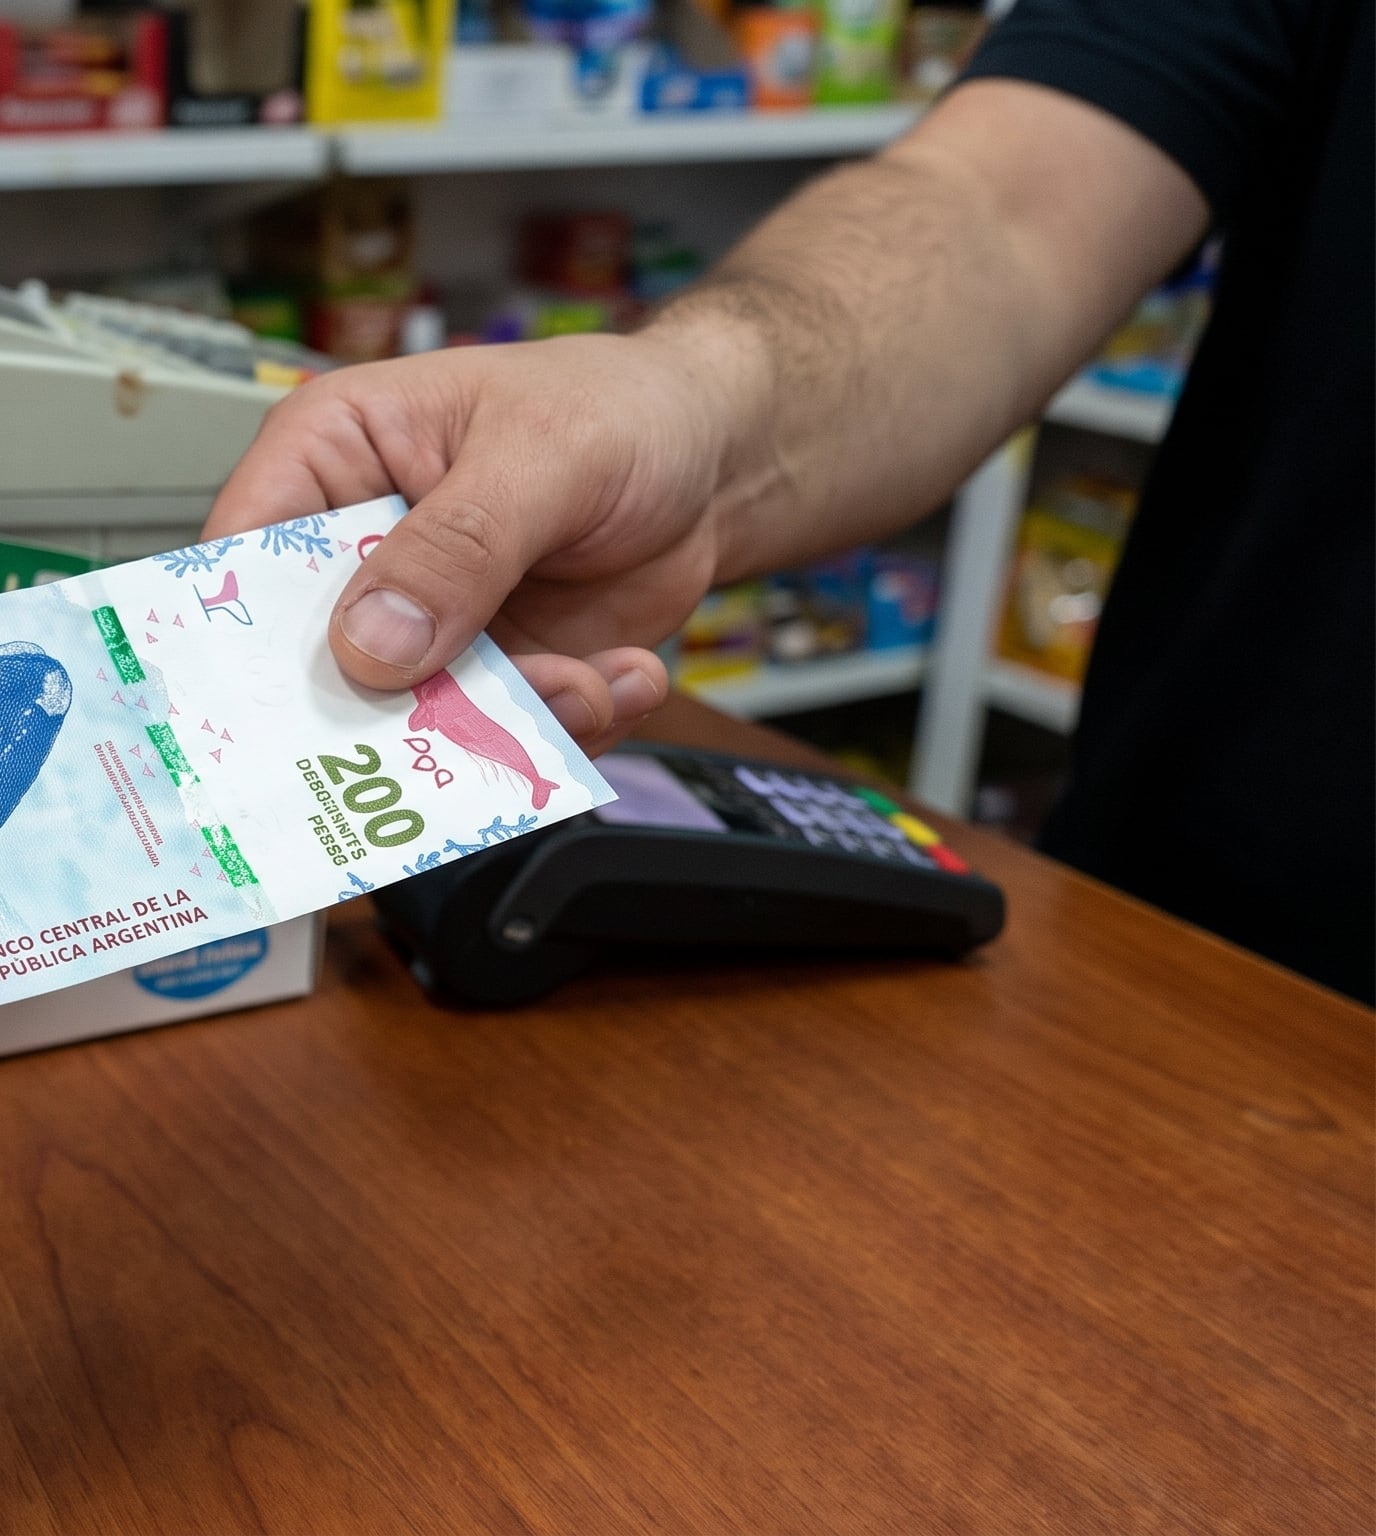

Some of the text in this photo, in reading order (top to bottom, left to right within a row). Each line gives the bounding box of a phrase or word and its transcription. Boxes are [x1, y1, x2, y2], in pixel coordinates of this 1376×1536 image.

[317, 744, 424, 847] 200
[40, 908, 131, 945] CENTRAL
[132, 897, 161, 917] DE
[164, 889, 191, 907] LA
[92, 906, 209, 953] ARGENTINA
